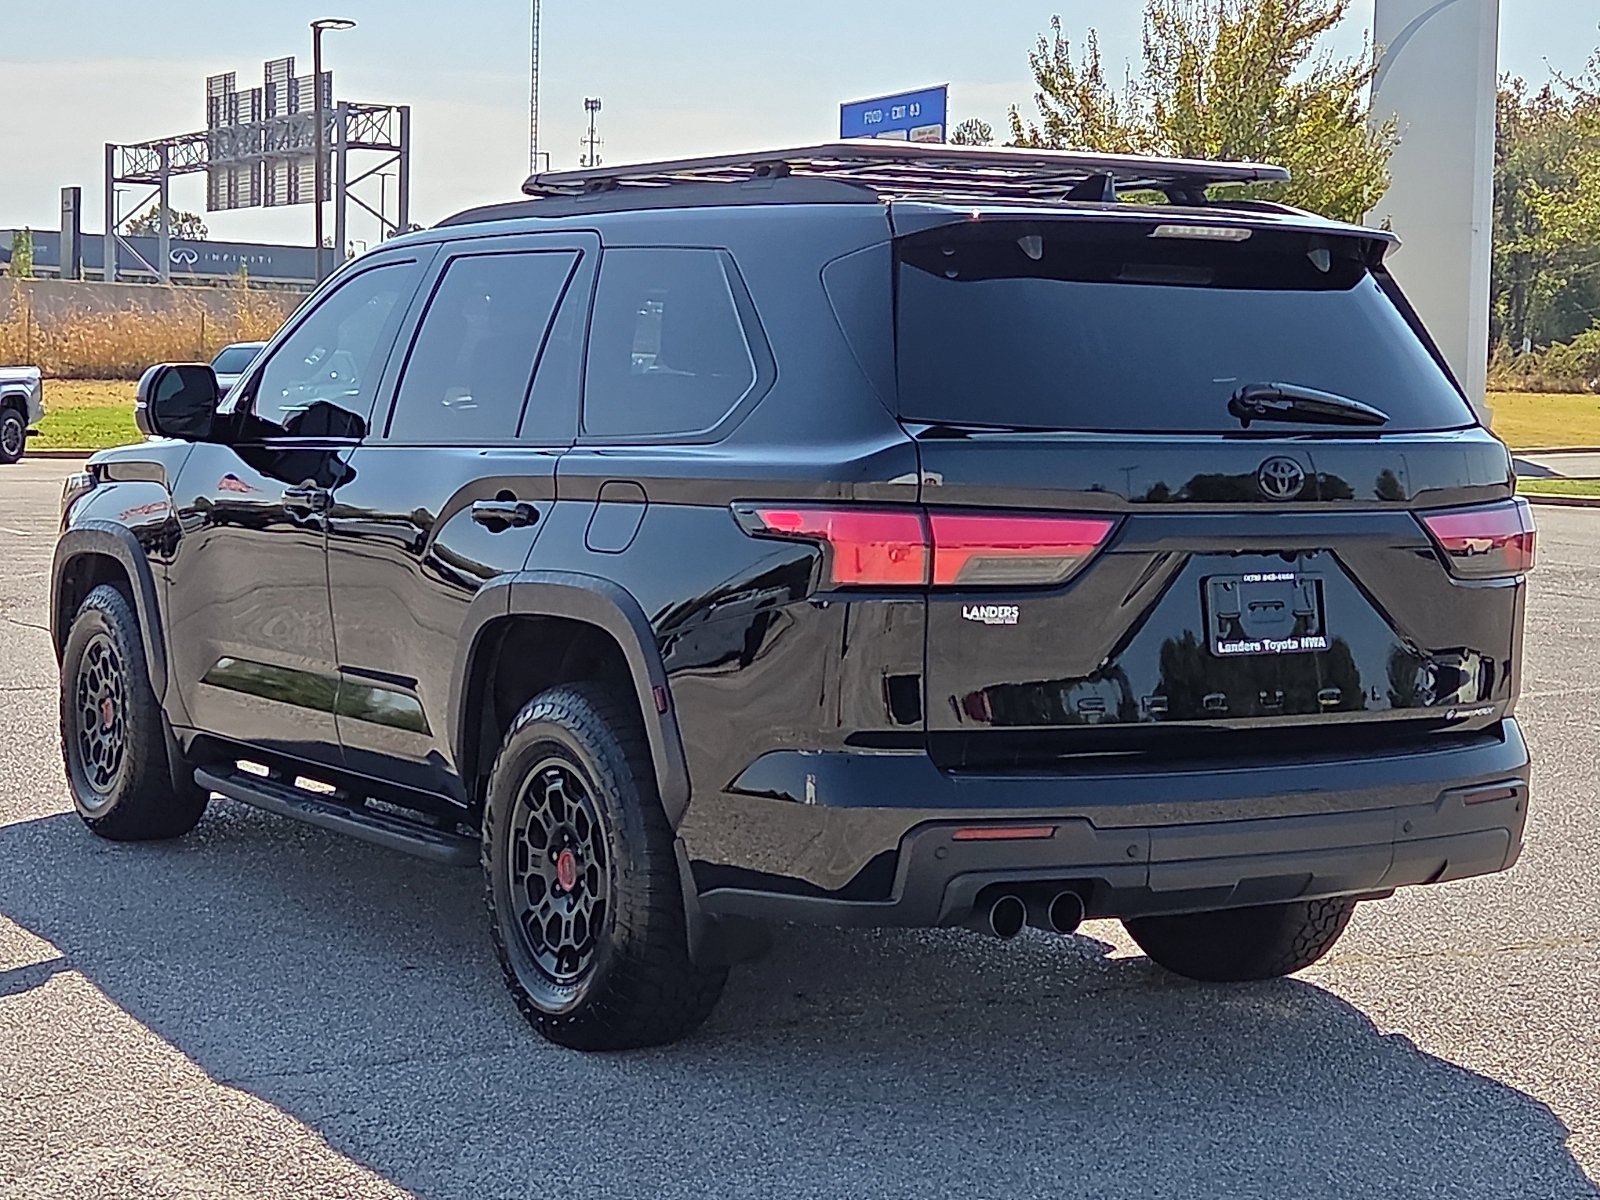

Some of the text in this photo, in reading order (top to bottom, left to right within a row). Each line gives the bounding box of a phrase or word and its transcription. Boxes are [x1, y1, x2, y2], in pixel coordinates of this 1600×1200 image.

[204, 252, 272, 264] INFINITI
[962, 605, 1019, 619] LANDERS
[1217, 637, 1327, 653] Landers Toyota NWA
